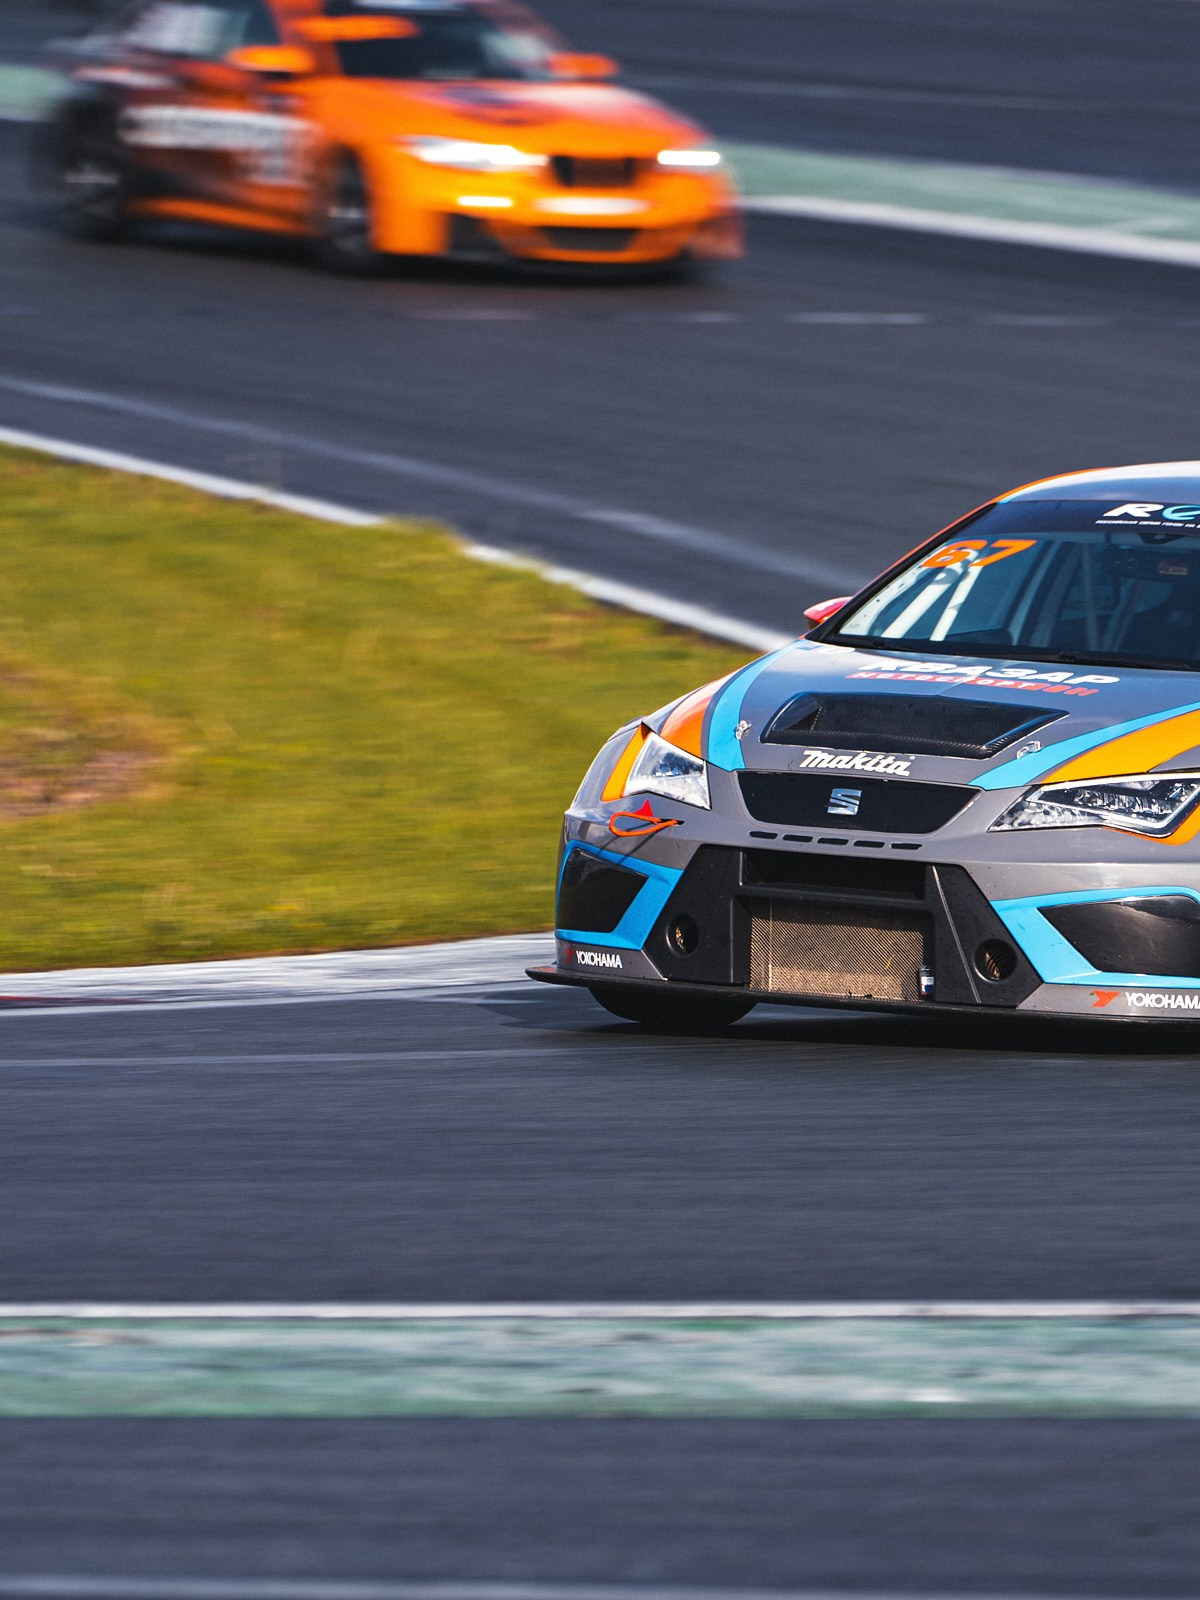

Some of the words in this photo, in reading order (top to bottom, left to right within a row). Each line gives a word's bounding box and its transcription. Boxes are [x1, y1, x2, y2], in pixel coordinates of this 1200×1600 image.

[921, 539, 1037, 567] 67
[800, 750, 913, 776] Makita
[576, 950, 623, 968] YOKOHAMA
